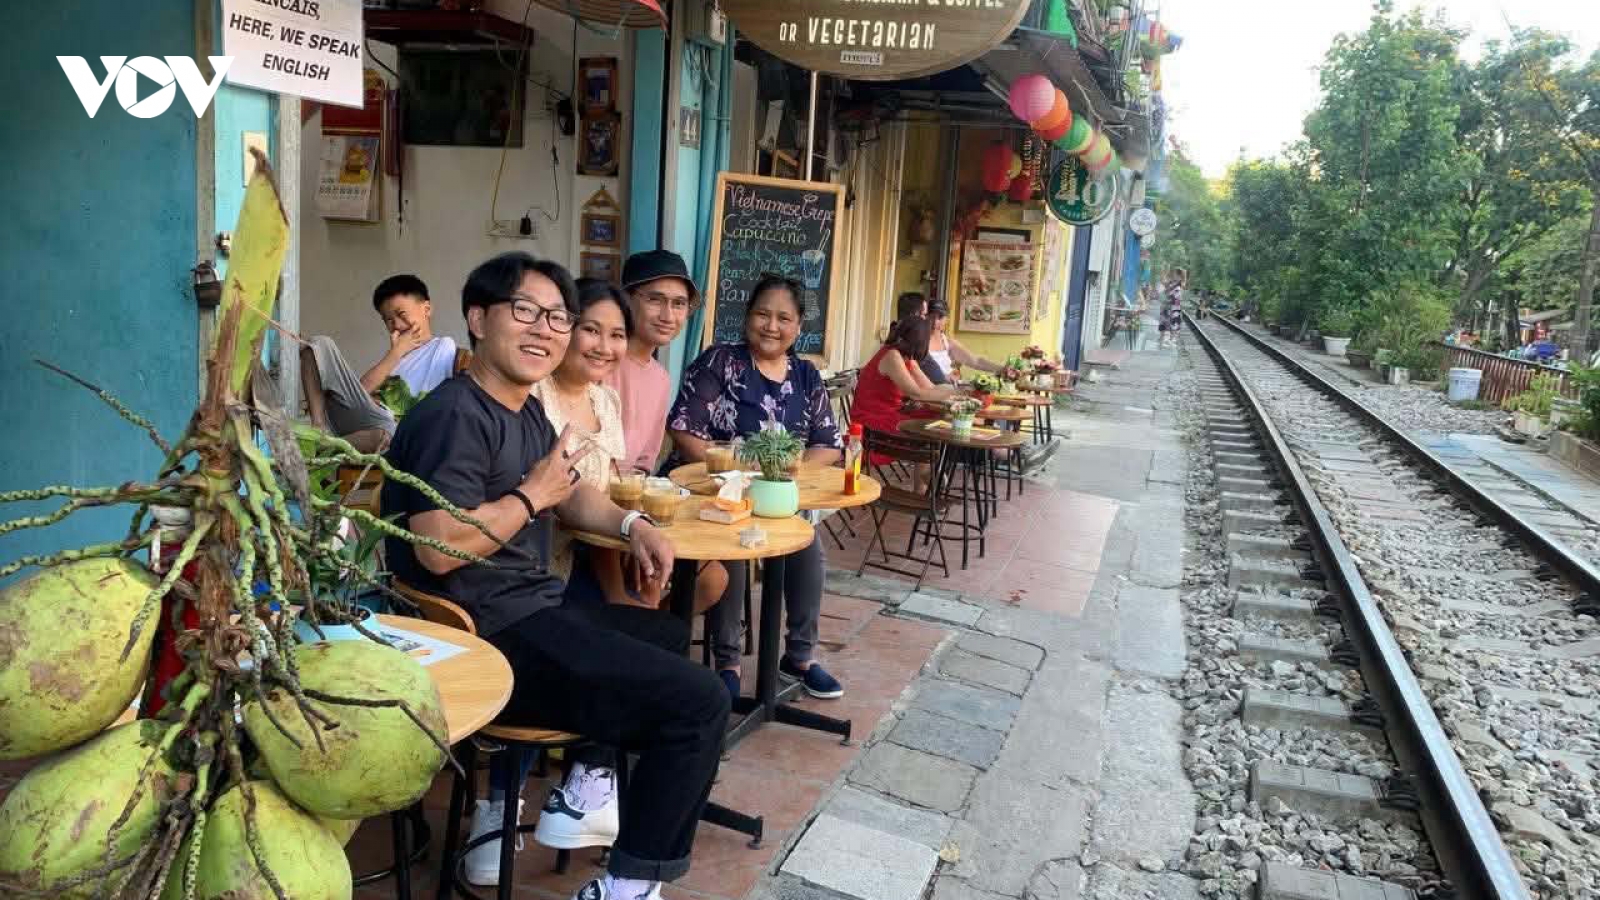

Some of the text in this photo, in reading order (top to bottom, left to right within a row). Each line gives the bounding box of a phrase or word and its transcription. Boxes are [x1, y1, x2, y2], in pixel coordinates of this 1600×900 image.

[229, 13, 360, 59] HERE, WE SPEAK
[779, 16, 936, 50] OR VEGETARIAN
[262, 53, 330, 81] ENGLISH
